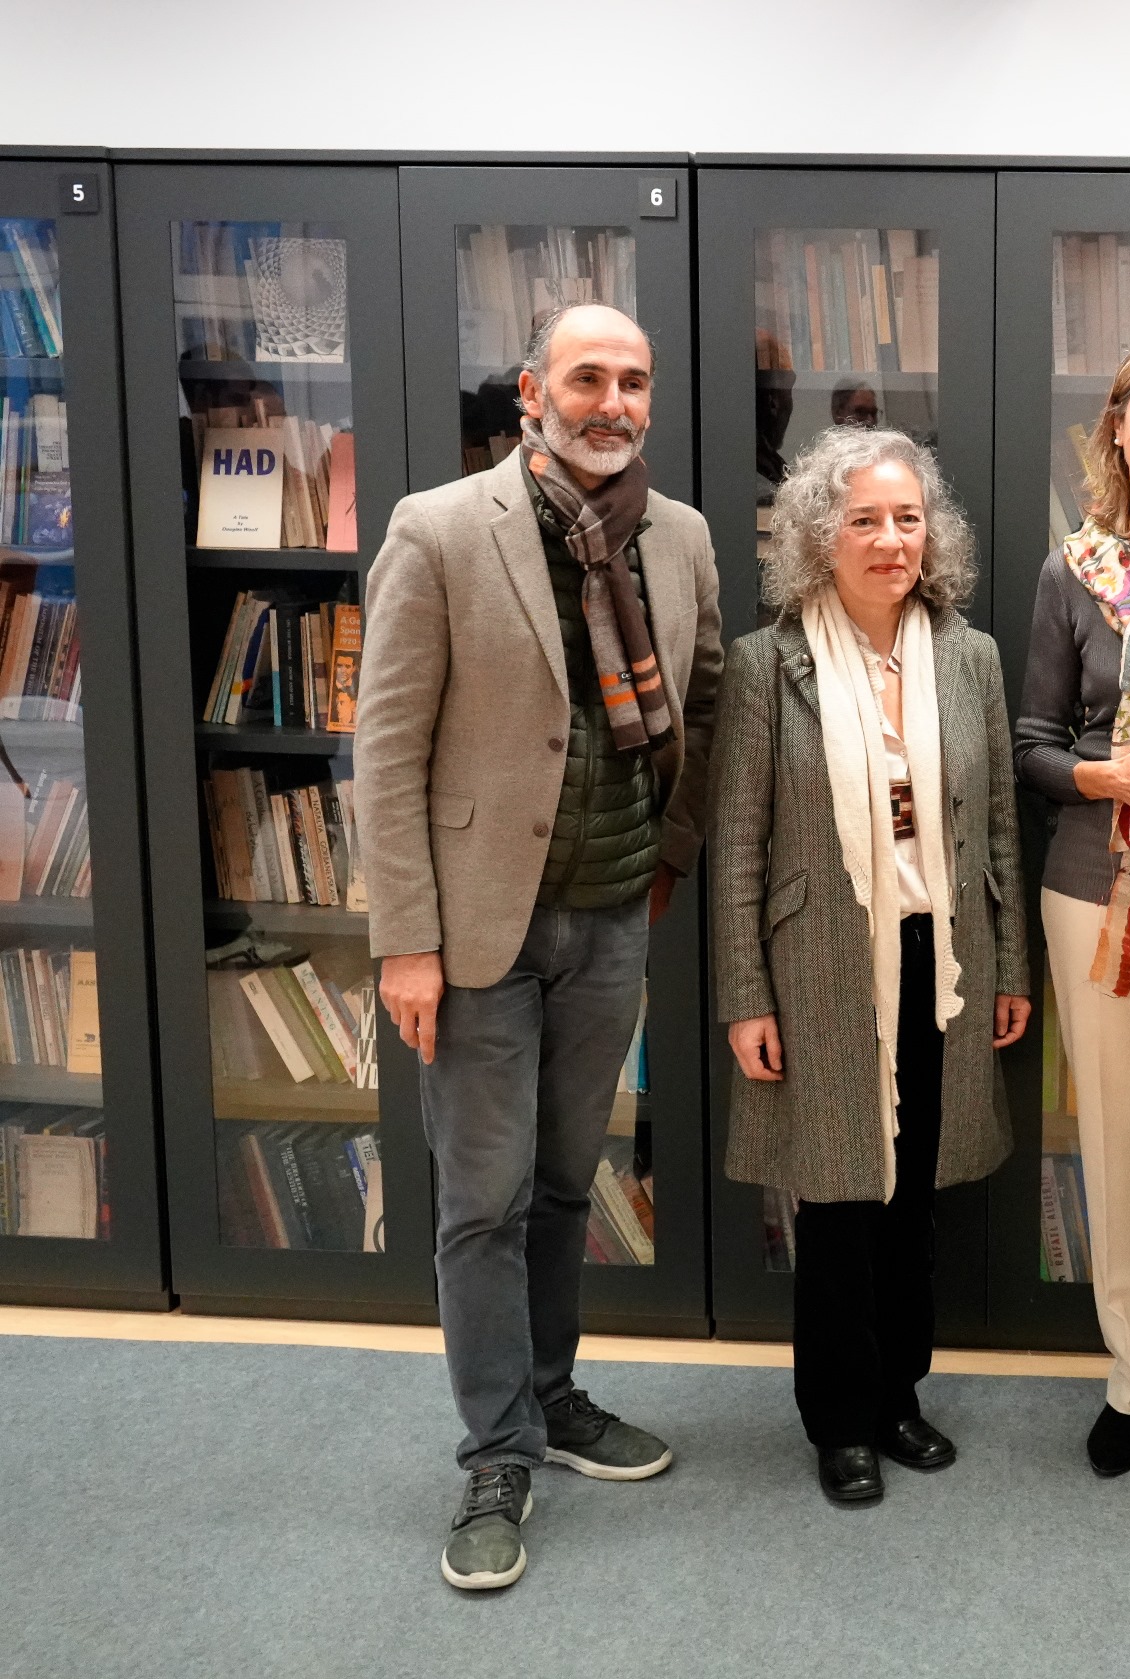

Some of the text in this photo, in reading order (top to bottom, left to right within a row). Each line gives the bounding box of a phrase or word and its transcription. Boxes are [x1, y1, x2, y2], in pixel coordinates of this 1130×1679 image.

[72, 184, 84, 202] 5
[650, 188, 663, 206] 6
[212, 448, 276, 476] HAD
[340, 616, 347, 624] A
[312, 800, 325, 834] NATALYA
[1049, 1224, 1065, 1267] RAFAEL
